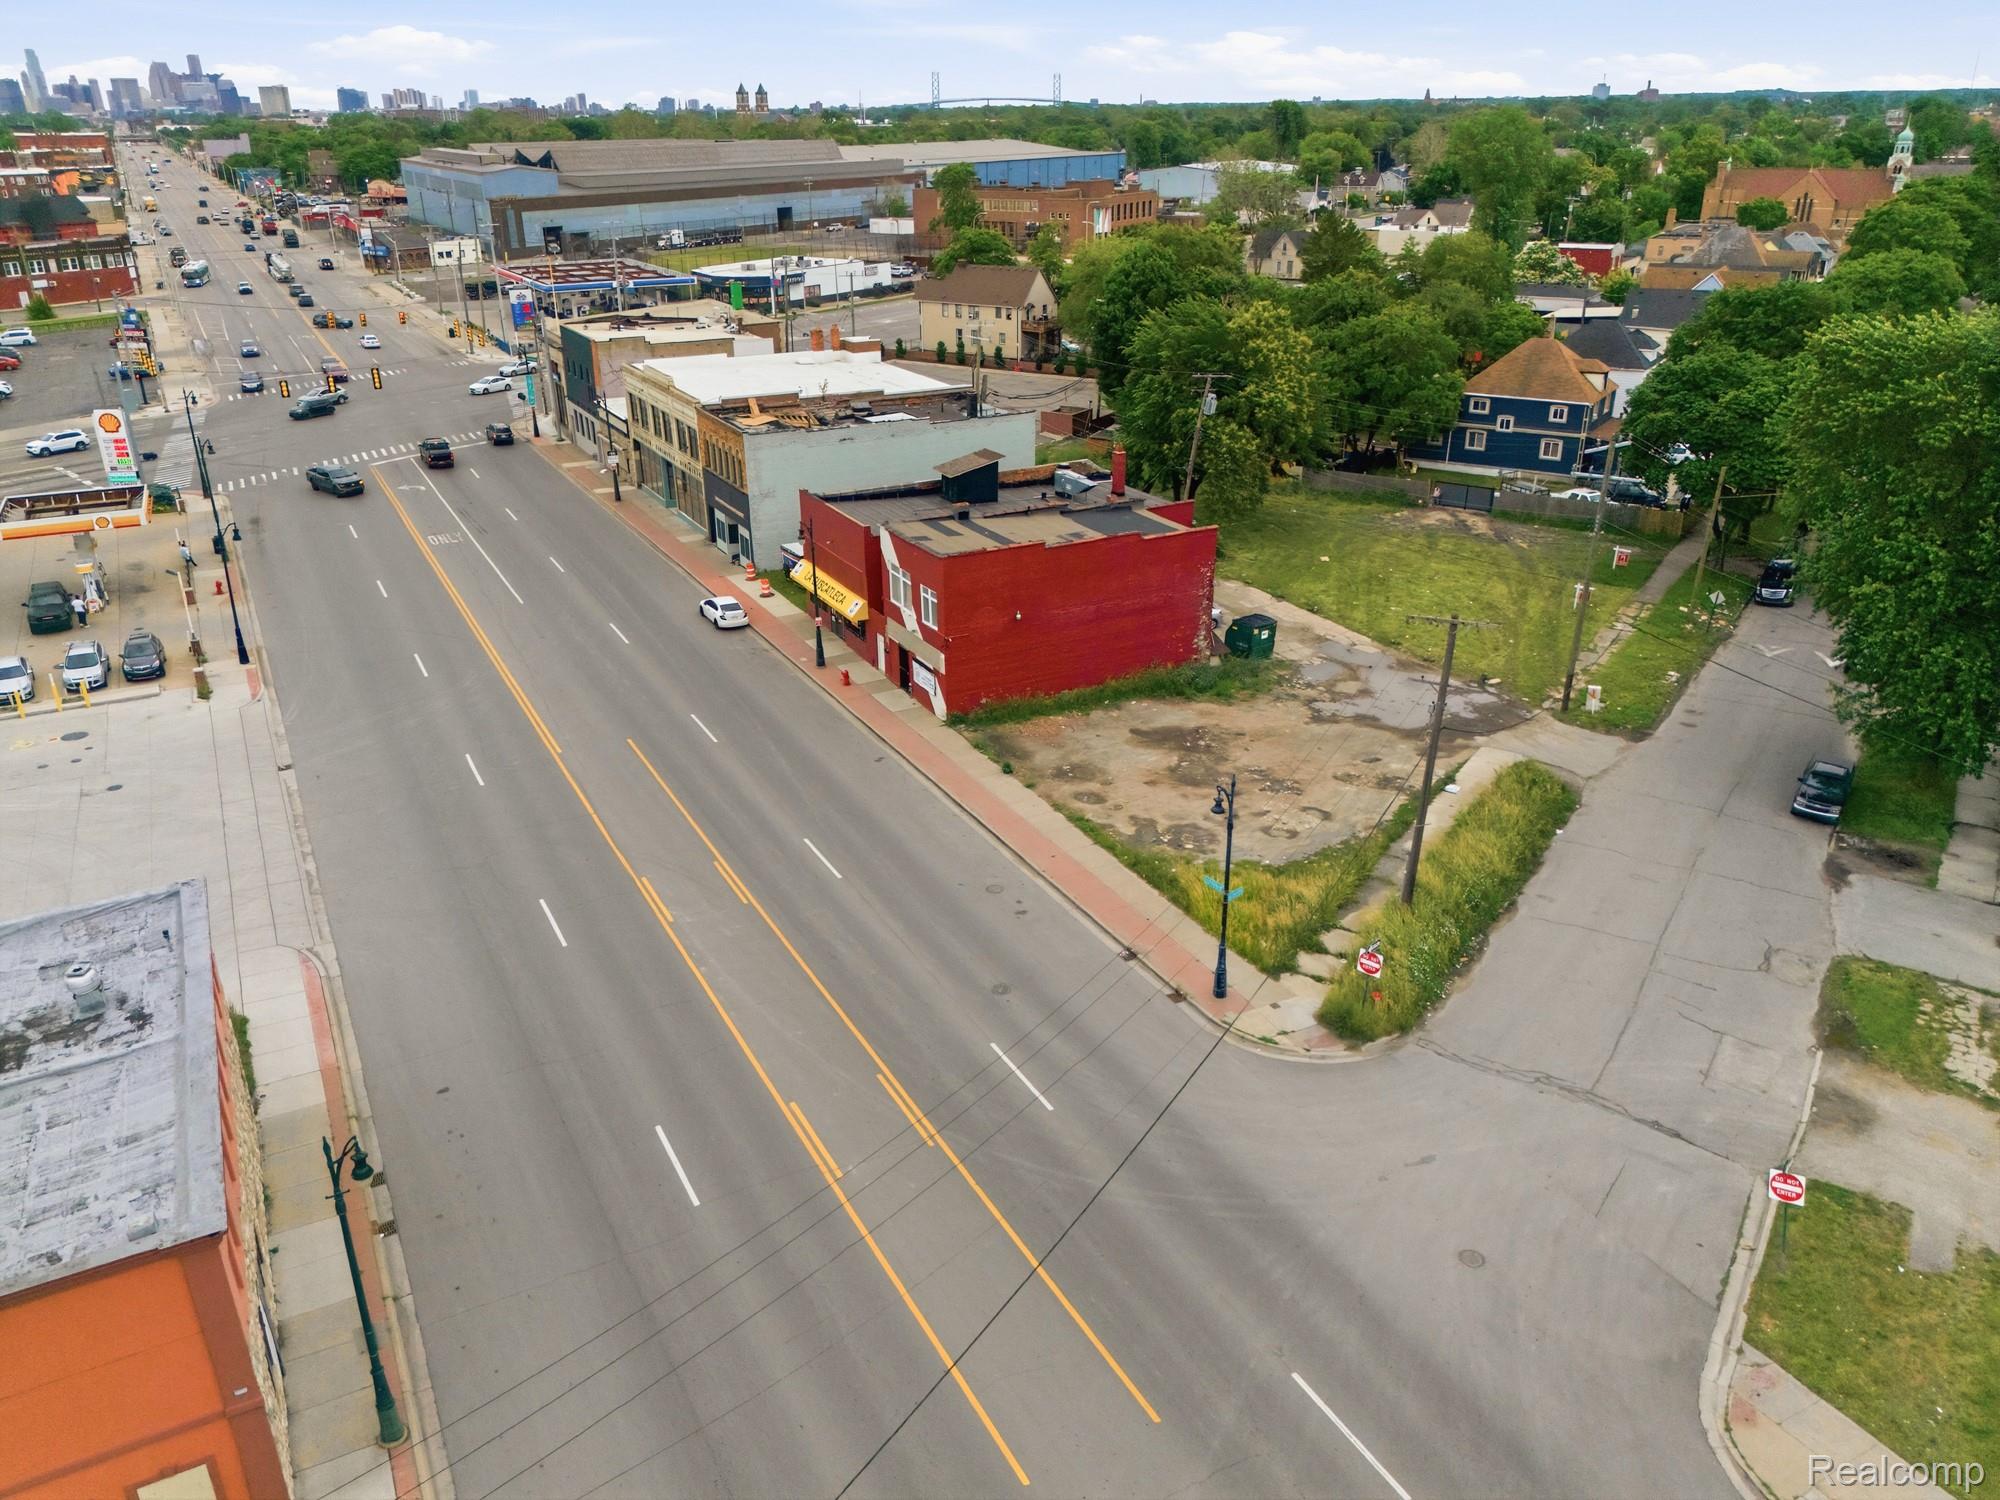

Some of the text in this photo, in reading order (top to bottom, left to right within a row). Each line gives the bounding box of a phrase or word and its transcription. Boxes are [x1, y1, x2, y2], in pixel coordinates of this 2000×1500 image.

[428, 532, 464, 545] ONLY
[1786, 1178, 1800, 1186] NOT
[1776, 1188, 1797, 1198] ENTER
